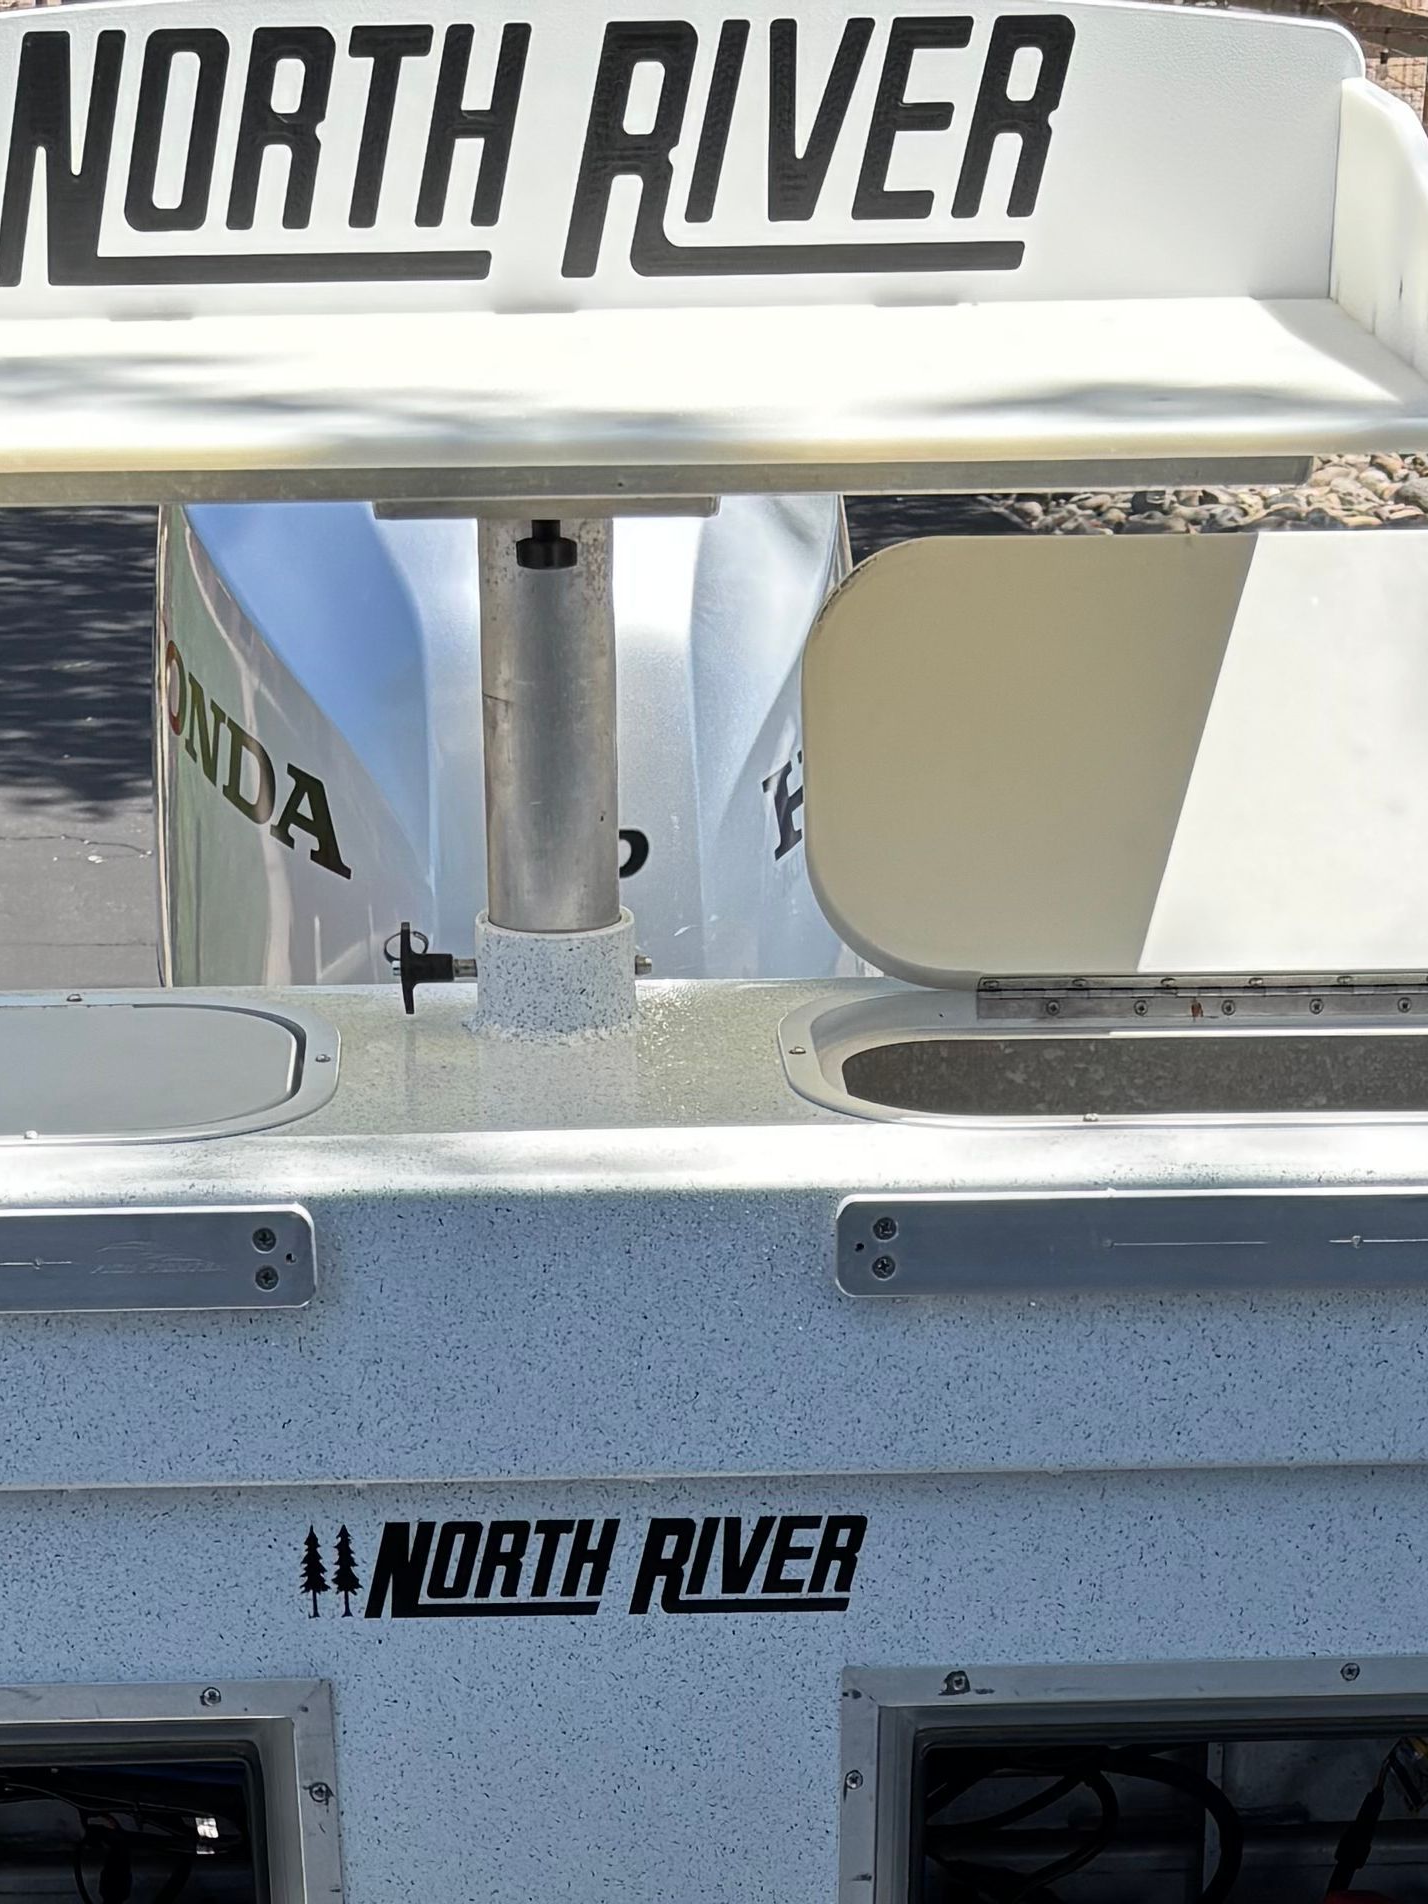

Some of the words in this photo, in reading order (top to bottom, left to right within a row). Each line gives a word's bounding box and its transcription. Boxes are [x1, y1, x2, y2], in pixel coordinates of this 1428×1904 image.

[561, 13, 1076, 278] RIVER
[165, 640, 352, 880] ONDA
[364, 1518, 620, 1619] NORTH
[629, 1515, 868, 1615] RIVER
